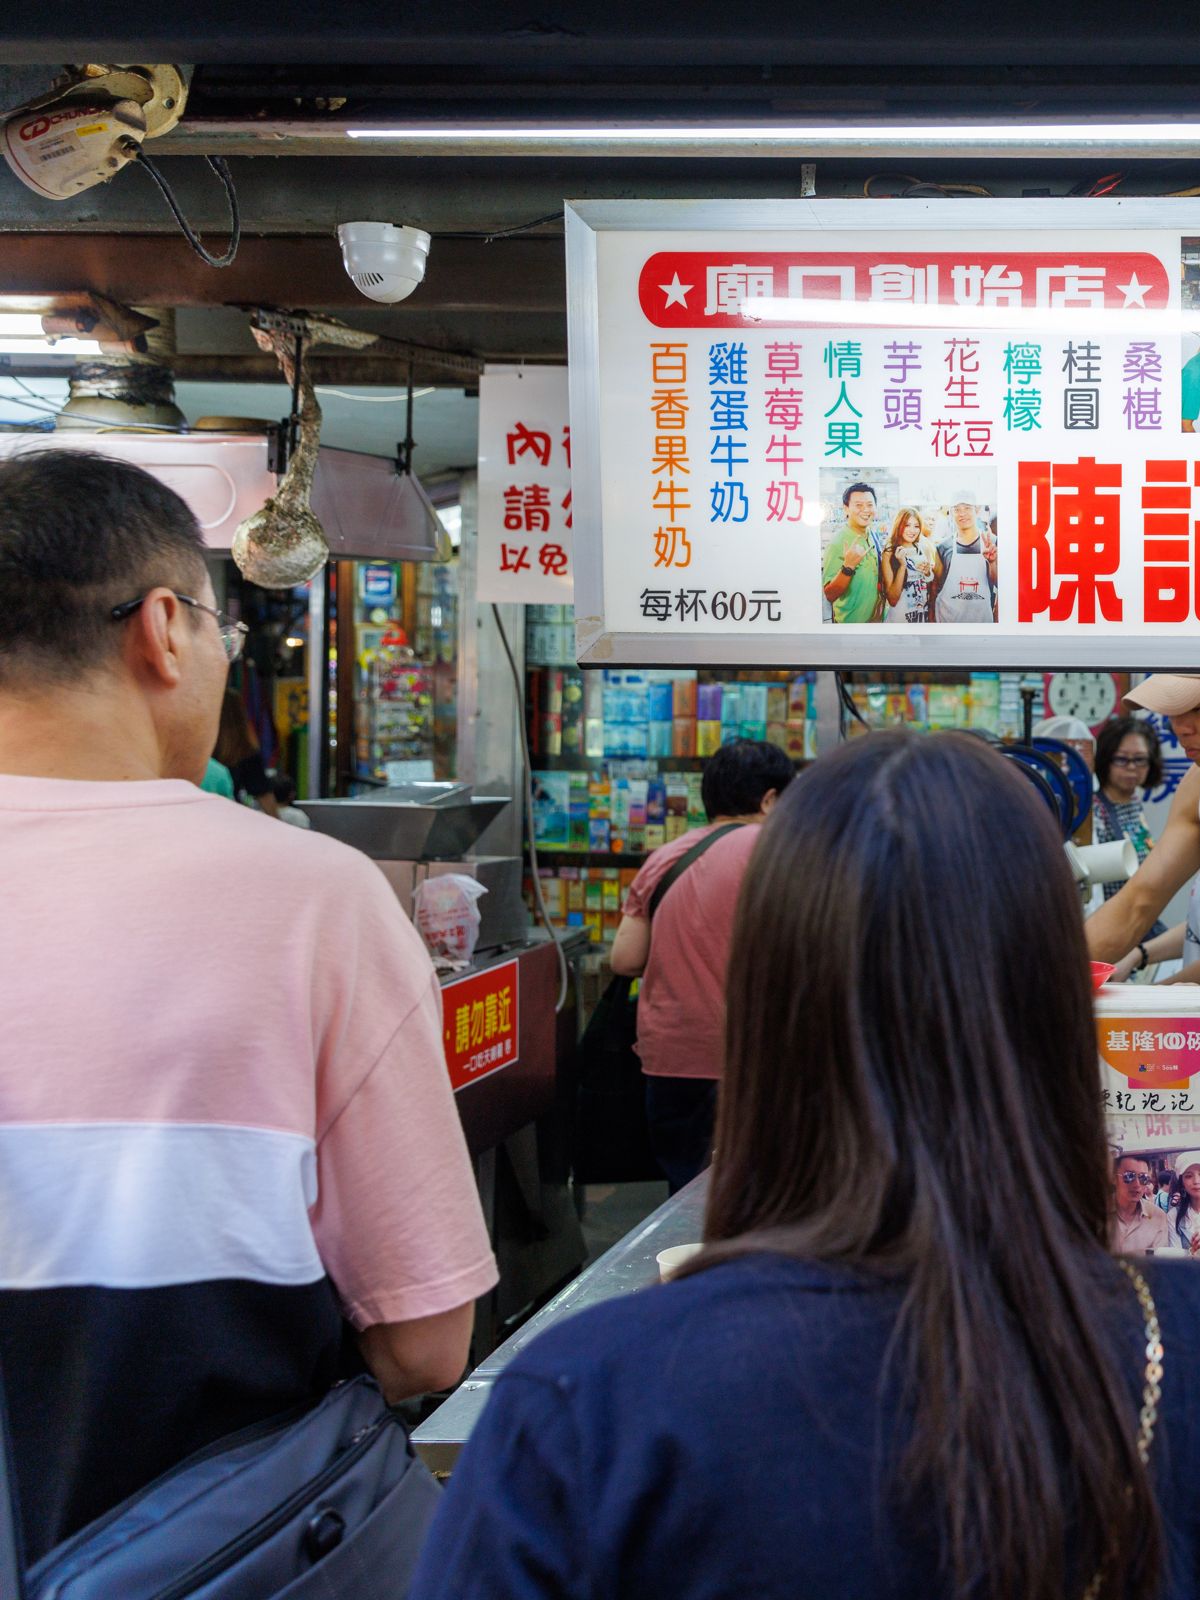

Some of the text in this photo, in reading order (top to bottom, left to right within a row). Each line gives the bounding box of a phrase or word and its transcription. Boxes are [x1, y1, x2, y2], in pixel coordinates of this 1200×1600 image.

[704, 264, 1106, 312] 廟口創始店
[824, 340, 863, 458] 情人果
[884, 341, 922, 430] 芋頭
[944, 338, 980, 408] 花生
[1003, 342, 1042, 431] 檸檬
[1062, 341, 1101, 430] 桂圓
[1123, 342, 1162, 430] 桑椹
[507, 422, 571, 468] 內
[650, 343, 691, 568] 百香果牛奶
[709, 342, 749, 522] 雞蛋牛奶
[764, 342, 803, 521] 草莓牛奶
[931, 419, 993, 457] 花豆
[640, 588, 781, 622] 每杯60元
[456, 986, 511, 1053] 請勿靠近
